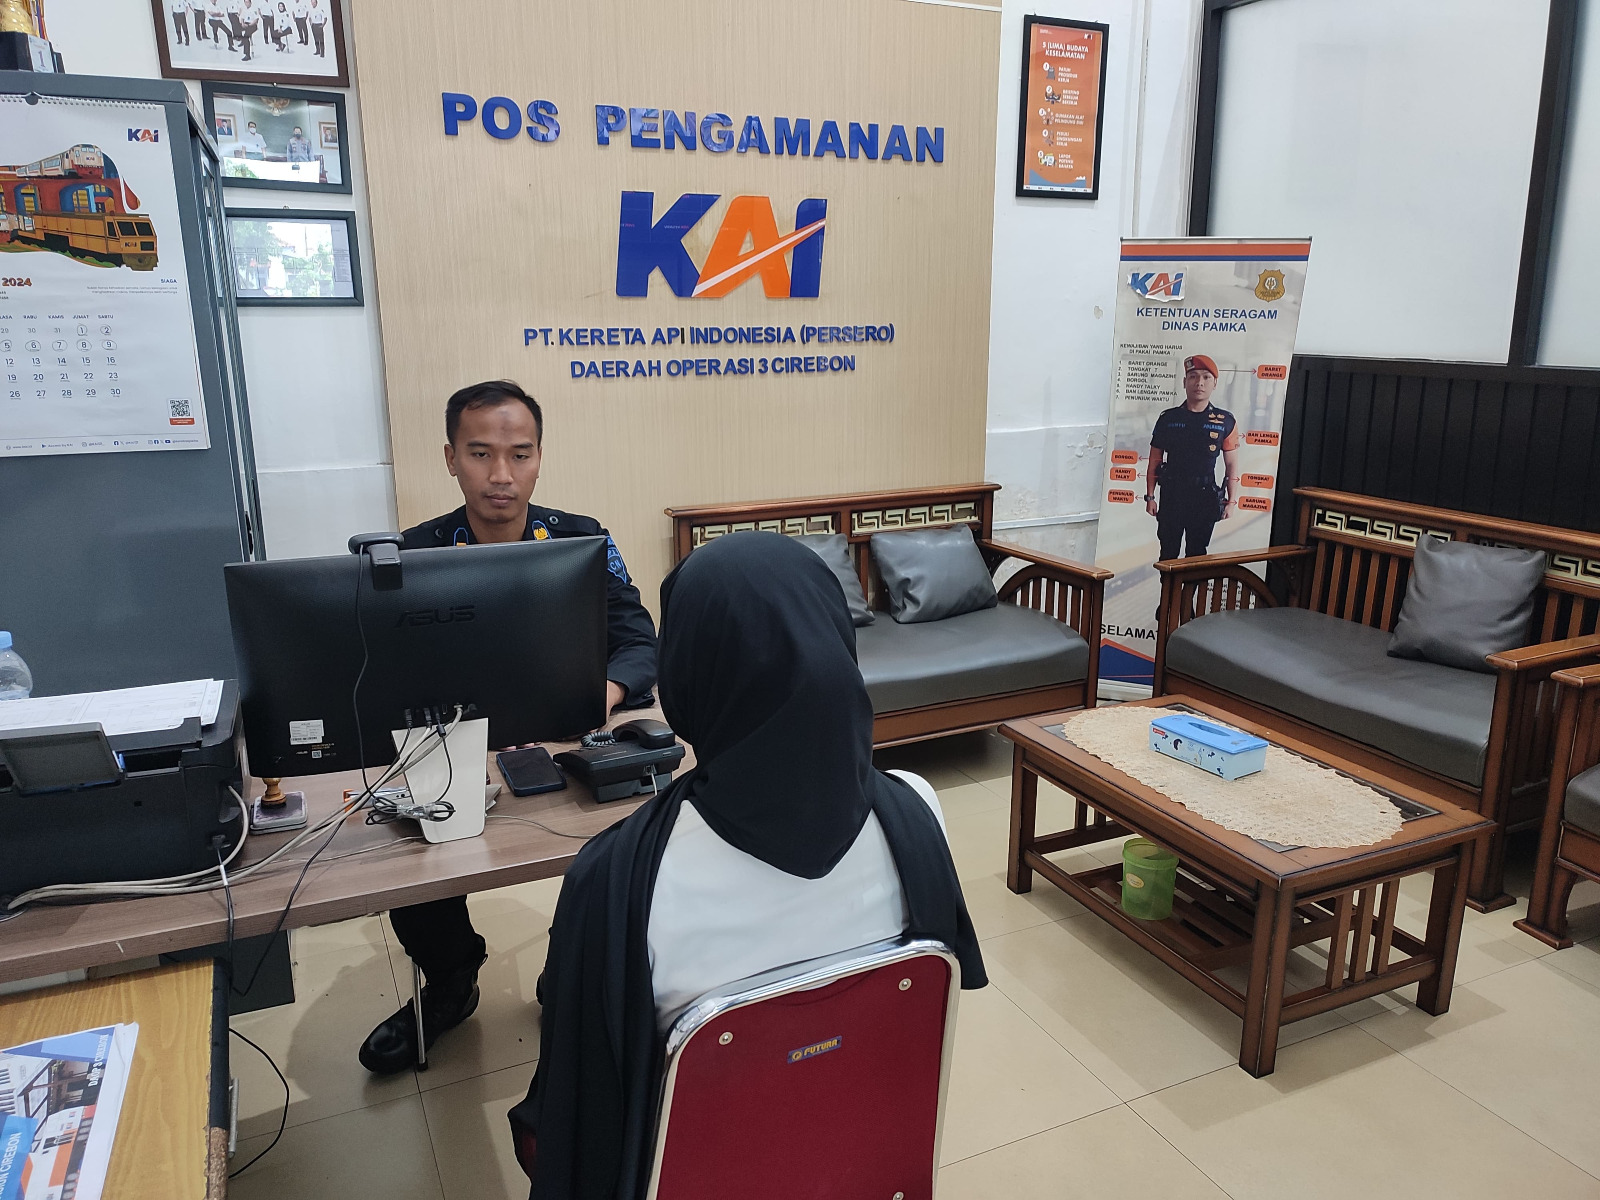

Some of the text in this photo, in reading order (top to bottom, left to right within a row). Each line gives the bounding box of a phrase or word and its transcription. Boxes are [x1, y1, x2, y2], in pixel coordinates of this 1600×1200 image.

[1045, 50, 1086, 60] KESELAMATAN
[1066, 44, 1089, 53] BUDAYA
[128, 128, 159, 142] KAI
[441, 91, 944, 163] POS PENGAMANAN
[615, 190, 828, 298] KAI
[1, 277, 32, 287] 2024
[1131, 272, 1184, 296] KAI
[1136, 307, 1278, 320] KETENTUAN SERAGAM
[523, 324, 895, 346] PT. KERETA API INDONESIA (PERSERO)
[1161, 320, 1247, 333] DINAS PAMKA
[570, 355, 856, 378] DAERAH OPERASI 3 CIREBON
[60, 372, 68, 380] 21
[9, 390, 21, 398] 26
[85, 388, 97, 396] 29
[394, 604, 475, 628] ASUS
[1101, 623, 1158, 640] SELAMA
[95, 1033, 109, 1062] CIREBON
[804, 1039, 838, 1056] FUTURA
[0, 1132, 22, 1172] CIREBON
